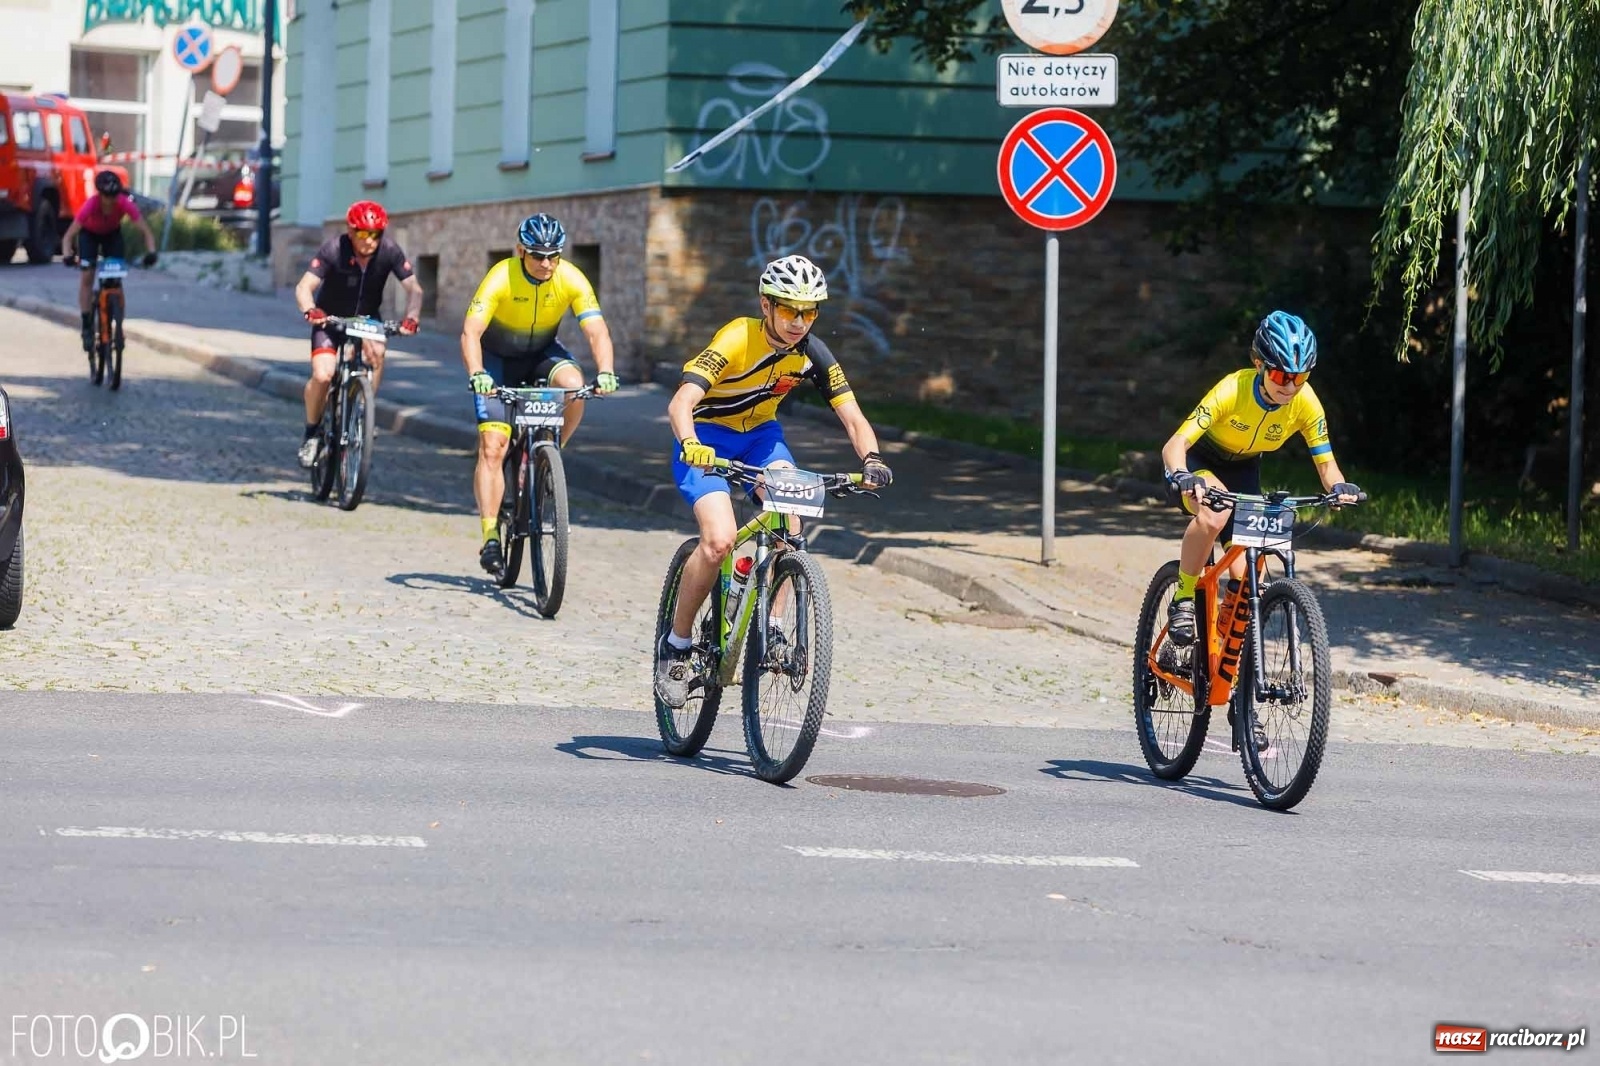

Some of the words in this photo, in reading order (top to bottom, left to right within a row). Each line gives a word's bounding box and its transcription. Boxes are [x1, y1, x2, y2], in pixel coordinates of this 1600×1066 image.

[1008, 62, 1036, 76] Nie
[1043, 62, 1107, 80] dotyczy
[1010, 83, 1100, 97] autokarów
[524, 401, 556, 414] 2032
[774, 481, 815, 500] 2230
[1246, 515, 1283, 533] 2031
